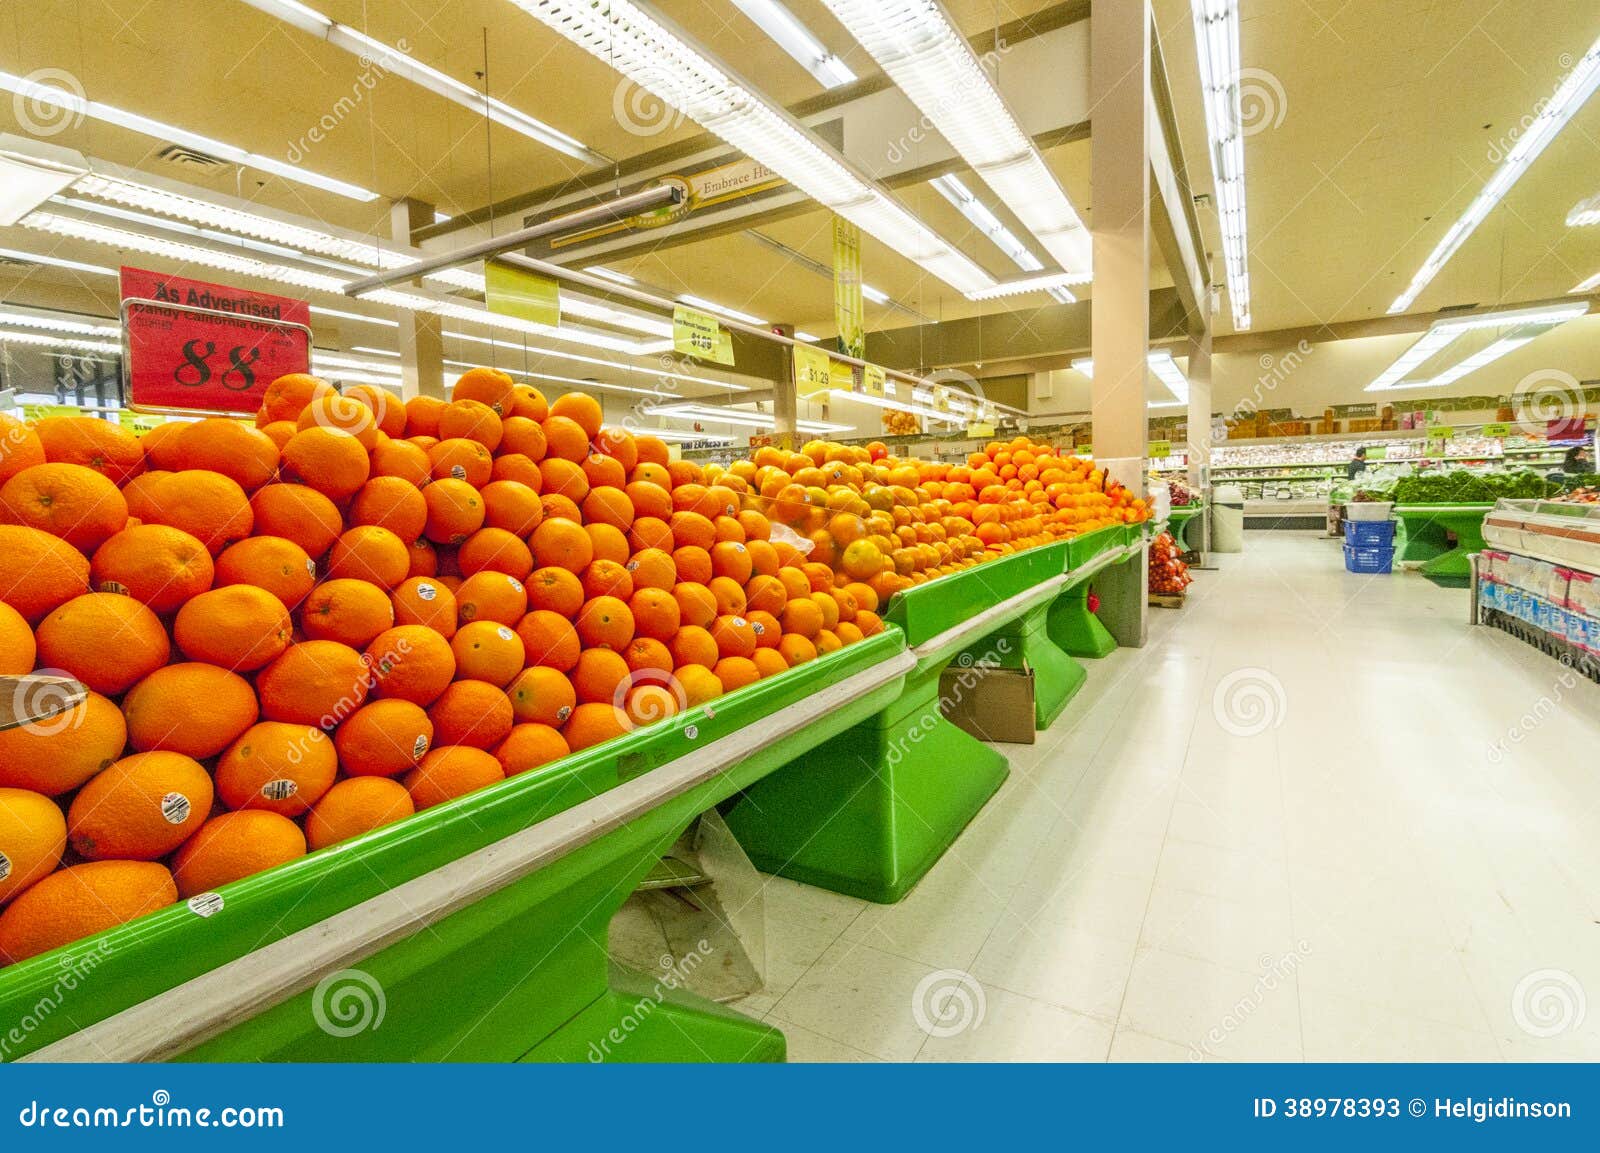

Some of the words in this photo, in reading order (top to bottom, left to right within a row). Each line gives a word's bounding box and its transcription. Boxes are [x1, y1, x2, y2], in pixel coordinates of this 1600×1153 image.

[703, 173, 750, 194] Embrace
[155, 282, 180, 302] As
[186, 287, 281, 320] Advertised
[174, 338, 261, 392] 88
